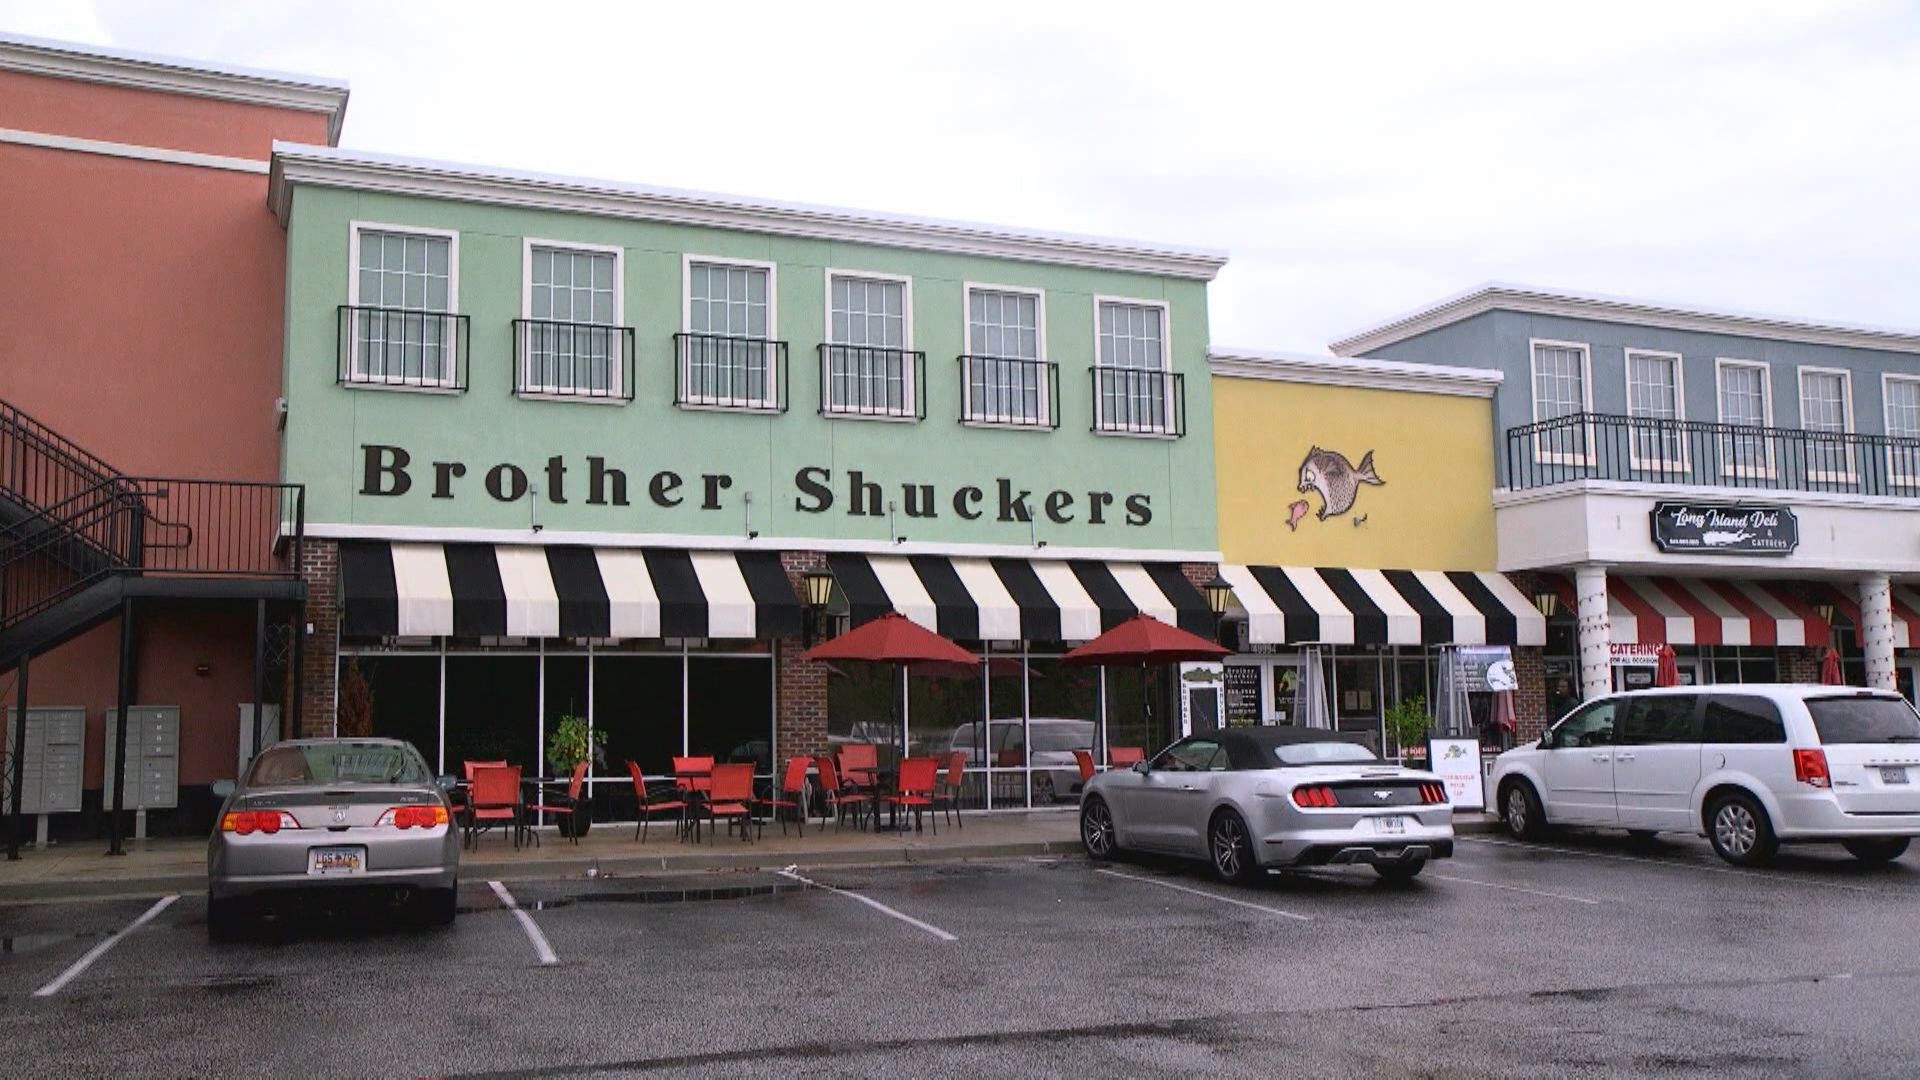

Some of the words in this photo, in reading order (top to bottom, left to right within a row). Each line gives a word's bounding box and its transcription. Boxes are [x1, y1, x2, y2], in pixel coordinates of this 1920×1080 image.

[358, 443, 733, 510] Brother
[794, 465, 1153, 526] Shuckers
[1670, 507, 1706, 528] Long
[1706, 509, 1748, 528] Island
[1750, 511, 1779, 527] Deli
[1609, 642, 1661, 656] CATERING
[1621, 656, 1631, 664] ALL
[1632, 656, 1657, 664] OCCASION
